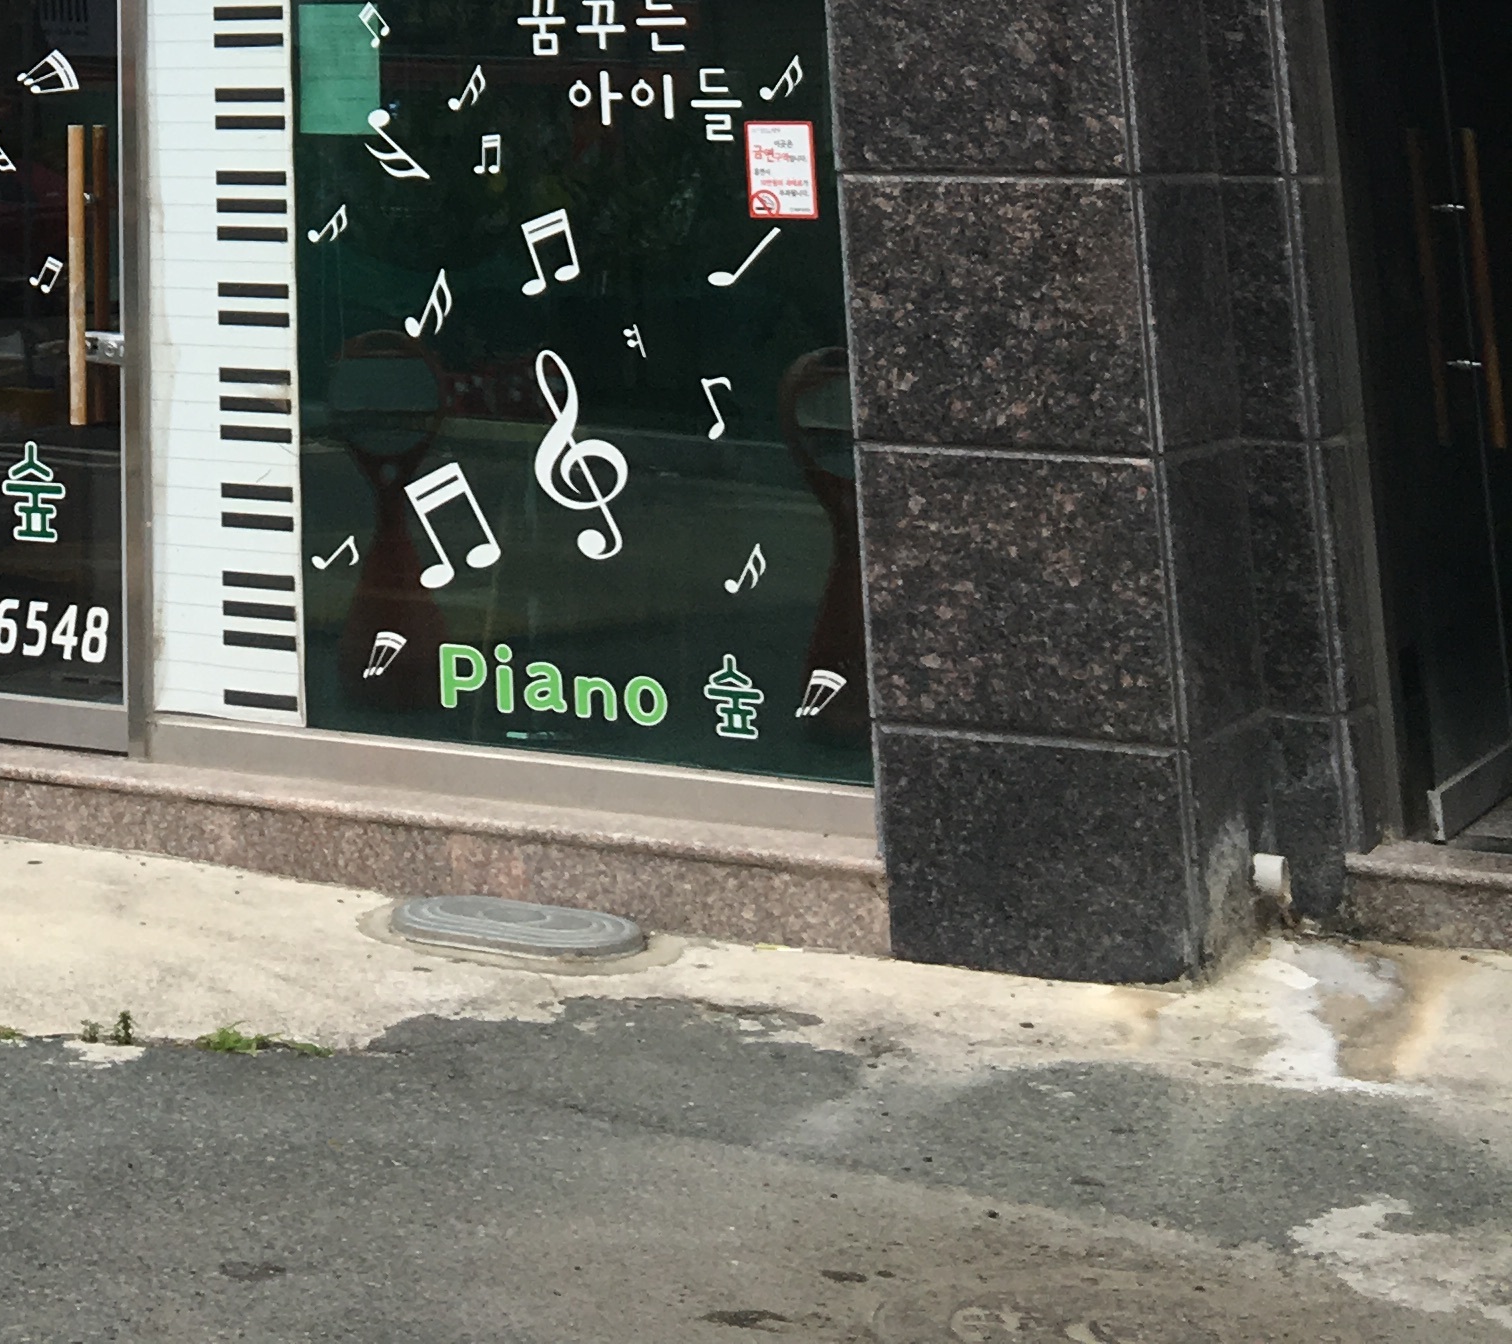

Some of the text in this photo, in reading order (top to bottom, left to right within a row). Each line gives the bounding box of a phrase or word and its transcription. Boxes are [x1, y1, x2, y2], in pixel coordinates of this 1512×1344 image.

[568, 68, 744, 142] 아이들
[438, 643, 765, 741] Piano 숲
